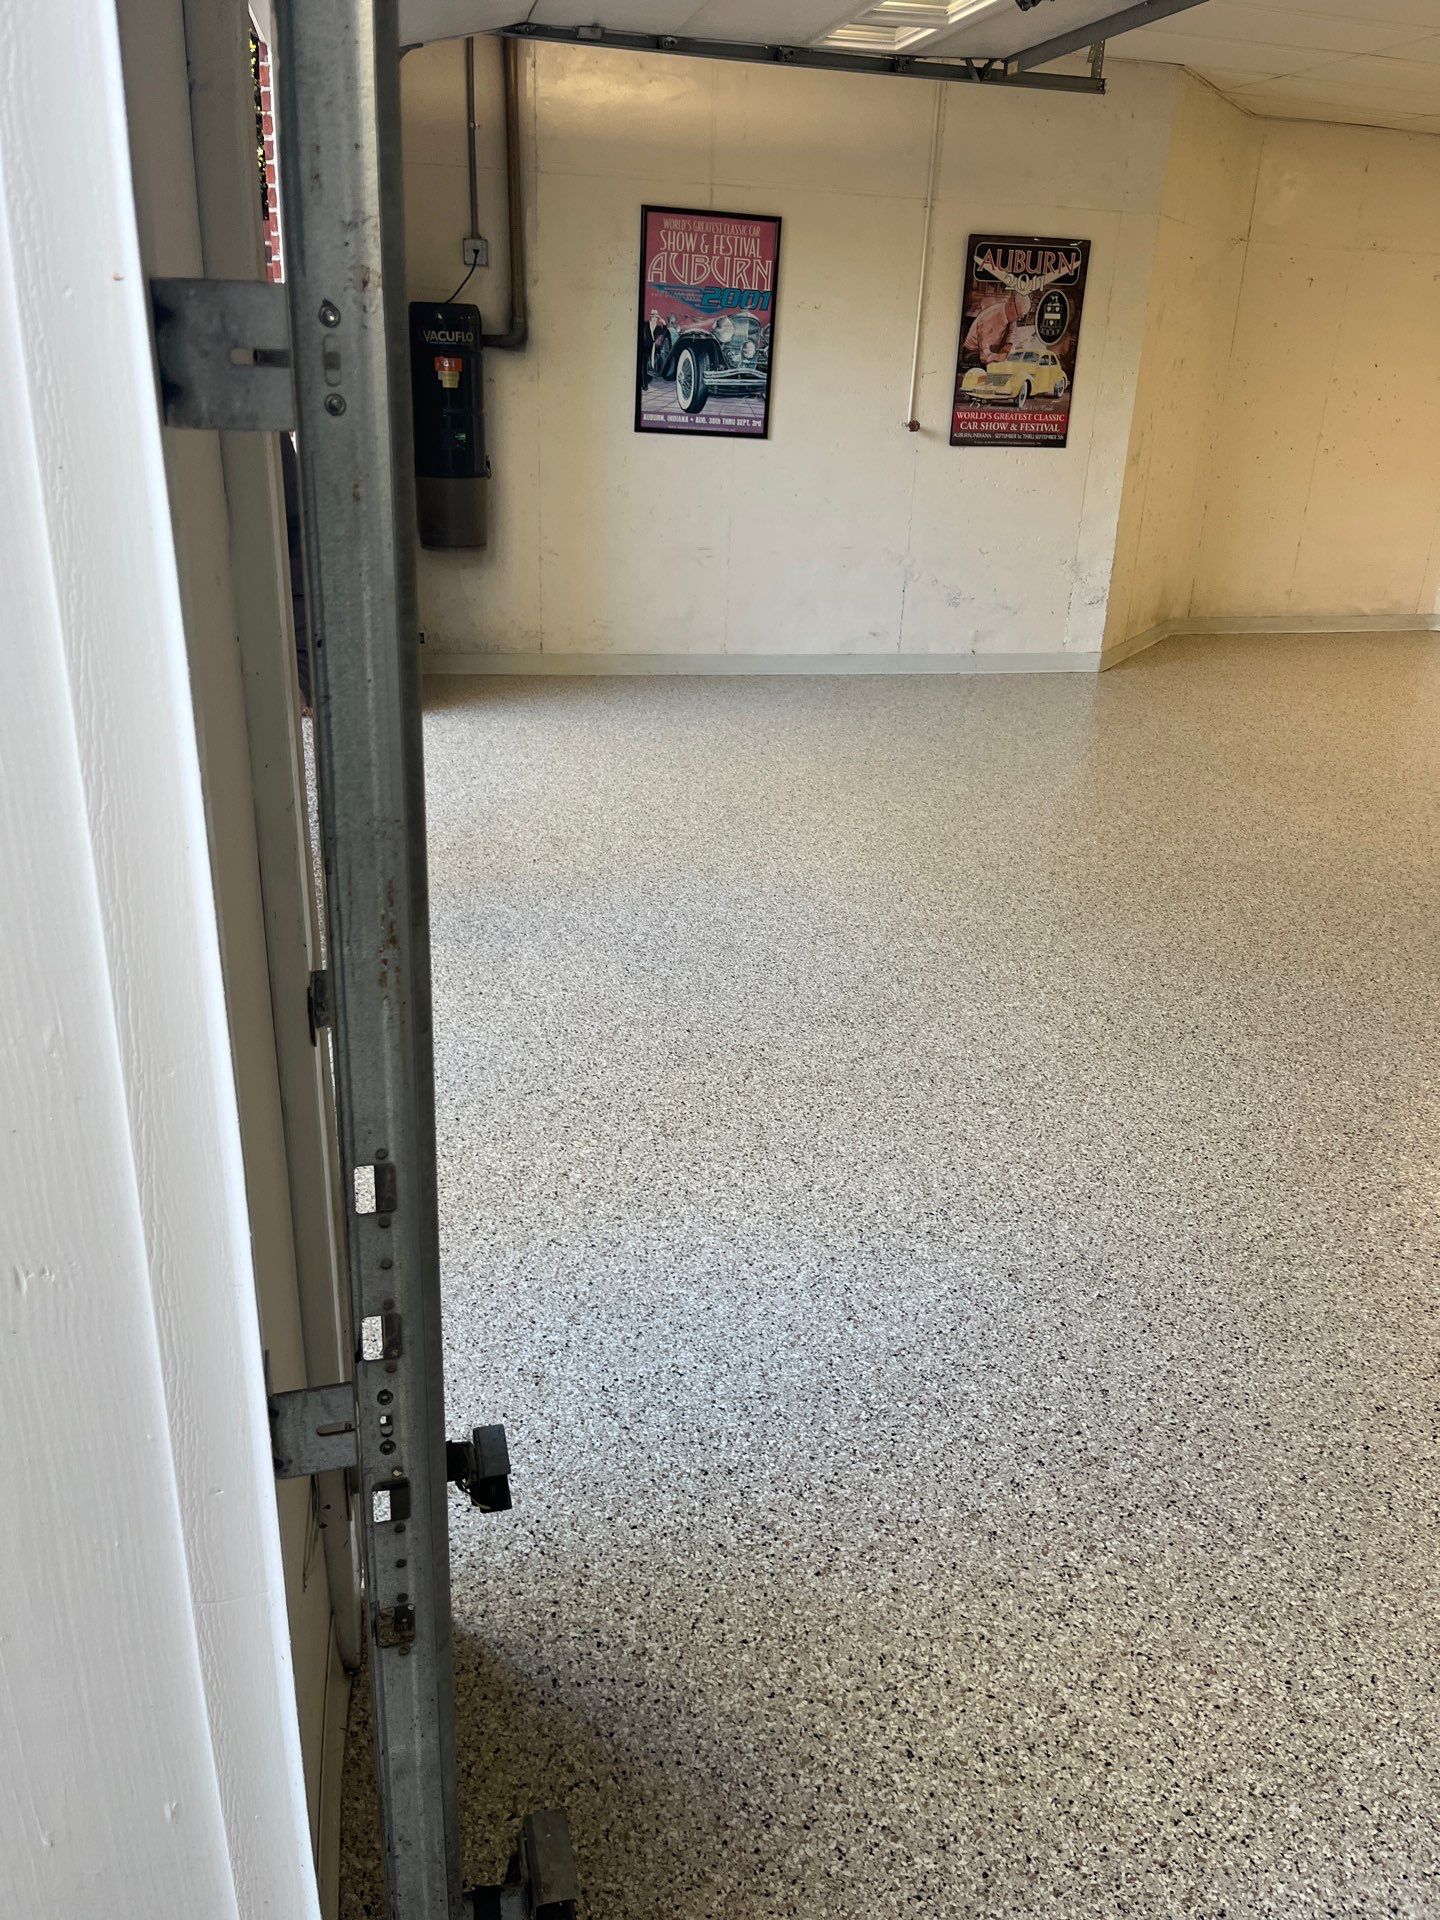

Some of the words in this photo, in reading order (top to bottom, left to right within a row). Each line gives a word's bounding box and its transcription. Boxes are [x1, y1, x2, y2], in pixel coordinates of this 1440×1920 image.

[663, 218, 692, 231] WORLD'S
[693, 220, 722, 234] GREATEST
[724, 223, 747, 236] CLASSIC
[748, 225, 761, 237] CAR
[660, 230, 697, 253] SHOW
[700, 233, 710, 254] &
[713, 234, 762, 259] FESTIVAL
[647, 252, 773, 291] AUBURN
[977, 248, 1077, 276] AUBURN
[1004, 273, 1046, 292] 2011
[701, 286, 773, 311] 2001
[423, 330, 475, 343] VACUFLO
[667, 415, 689, 423] INDIANA
[956, 411, 993, 420] WORLD'S
[994, 412, 1032, 421] GREATEST
[1034, 413, 1065, 422] CLASSIC
[960, 421, 978, 430] CAR
[980, 422, 1009, 431] SHOW
[1010, 423, 1018, 431] &
[1020, 423, 1060, 432] FESTIVAL
